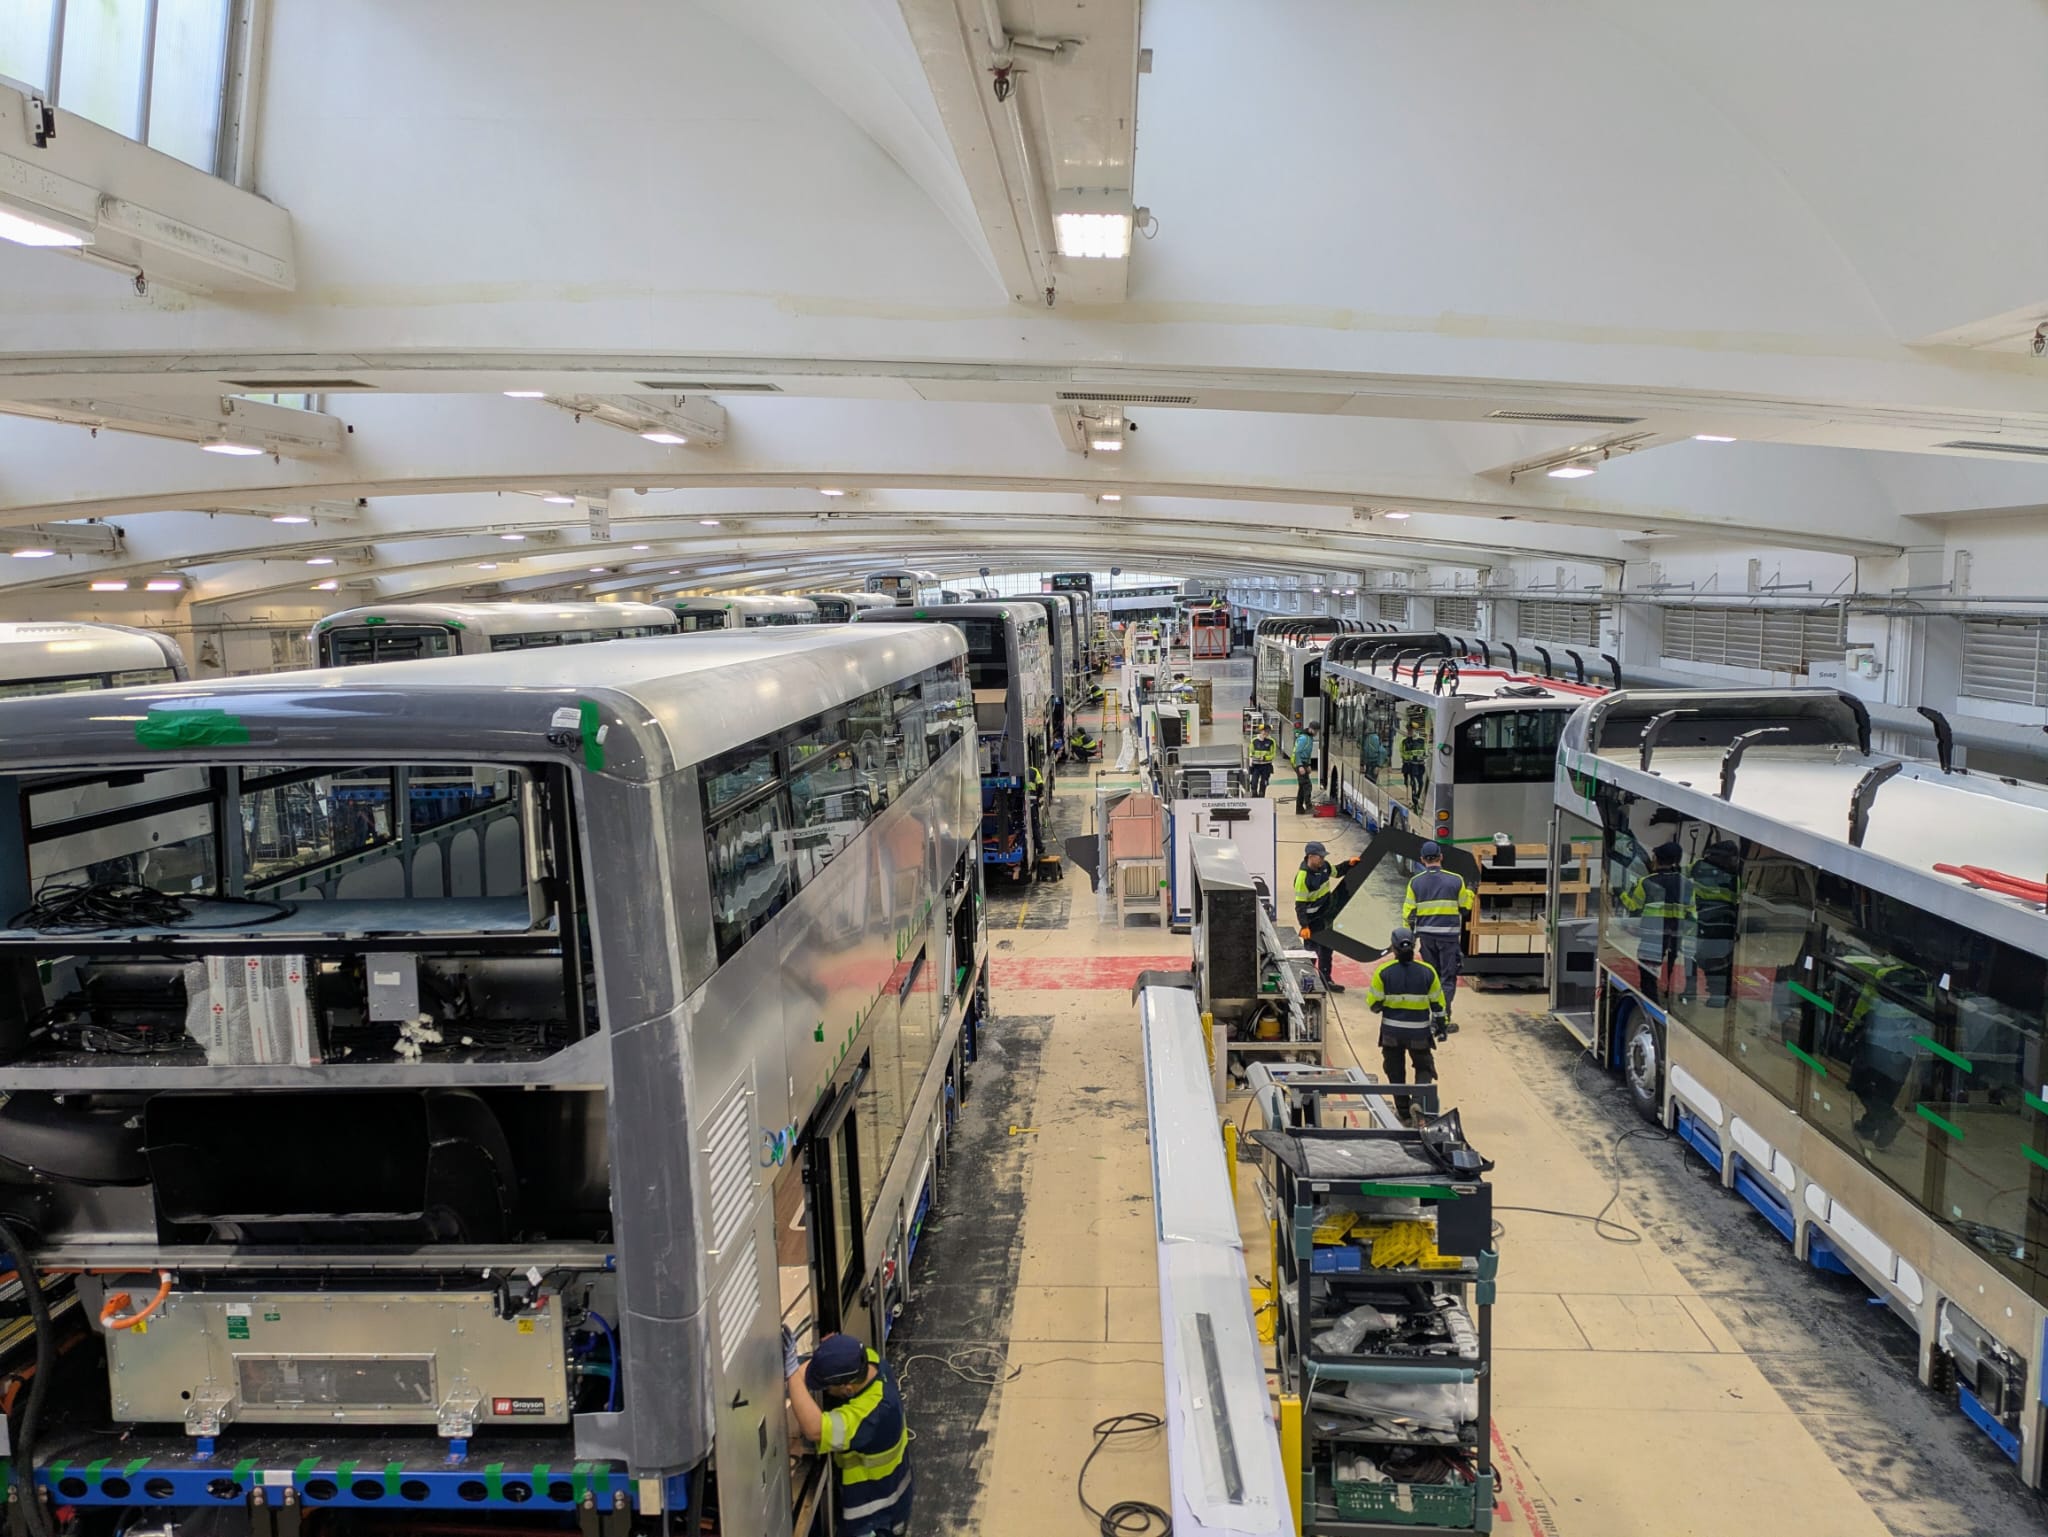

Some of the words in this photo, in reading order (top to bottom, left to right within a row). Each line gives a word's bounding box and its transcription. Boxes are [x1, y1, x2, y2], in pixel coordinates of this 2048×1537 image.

[250, 970, 259, 1002] HANOVER
[215, 1015, 223, 1047] HANOVER
[512, 1400, 544, 1409] Grayson
